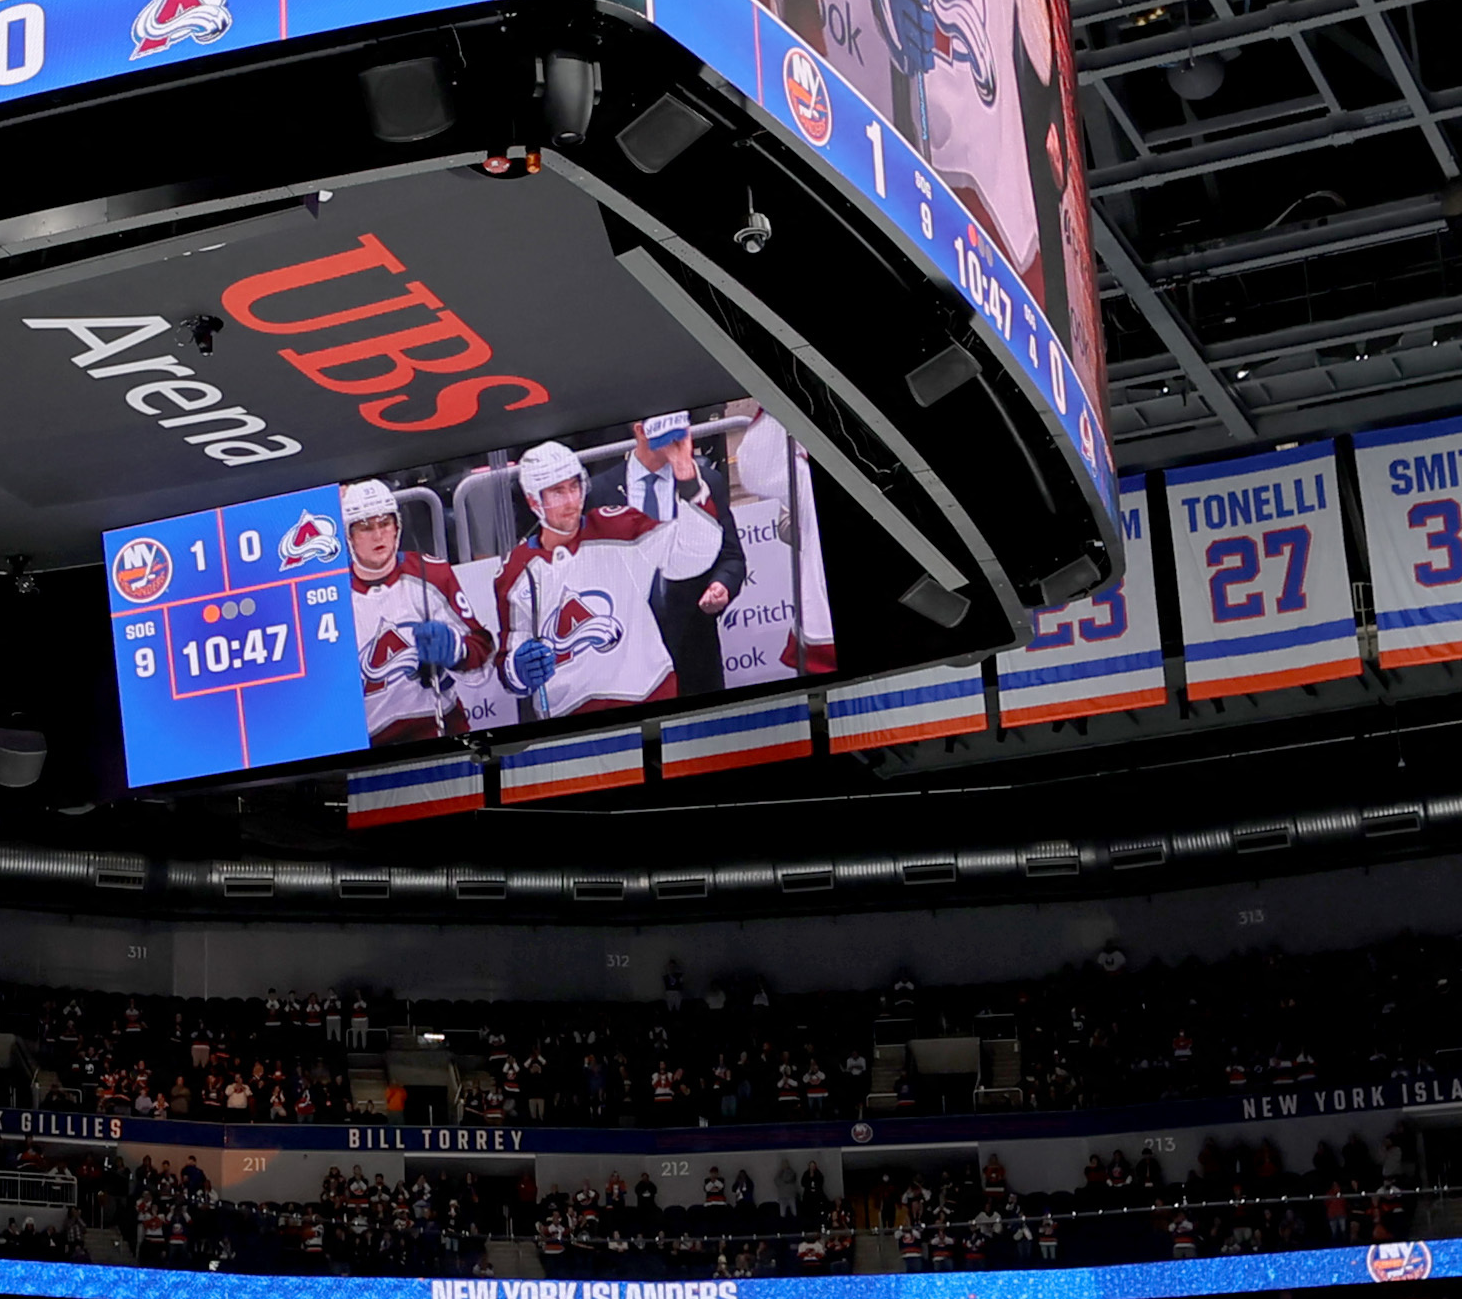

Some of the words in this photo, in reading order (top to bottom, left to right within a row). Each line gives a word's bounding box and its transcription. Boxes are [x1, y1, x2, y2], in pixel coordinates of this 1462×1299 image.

[865, 120, 886, 199] 1
[954, 236, 1012, 341] 10:47
[220, 232, 550, 432] UBS
[21, 315, 302, 467] Arena
[1181, 473, 1327, 535] TONELLI
[189, 539, 206, 571] 1
[239, 530, 262, 563] 0
[1204, 523, 1312, 624] 27
[306, 585, 338, 606] SOG
[125, 620, 156, 640] SOG
[317, 612, 340, 644] 4
[134, 647, 156, 678] 9
[181, 623, 289, 678] 10:47
[1243, 1091, 1297, 1120] NEW
[1315, 1084, 1384, 1114] YORK
[21, 1112, 122, 1139] GILLIES
[347, 1128, 402, 1148] BILL
[420, 1129, 525, 1152] TORREY
[1144, 1137, 1176, 1153] 213
[243, 1156, 266, 1173] 211
[661, 1160, 690, 1178] 212
